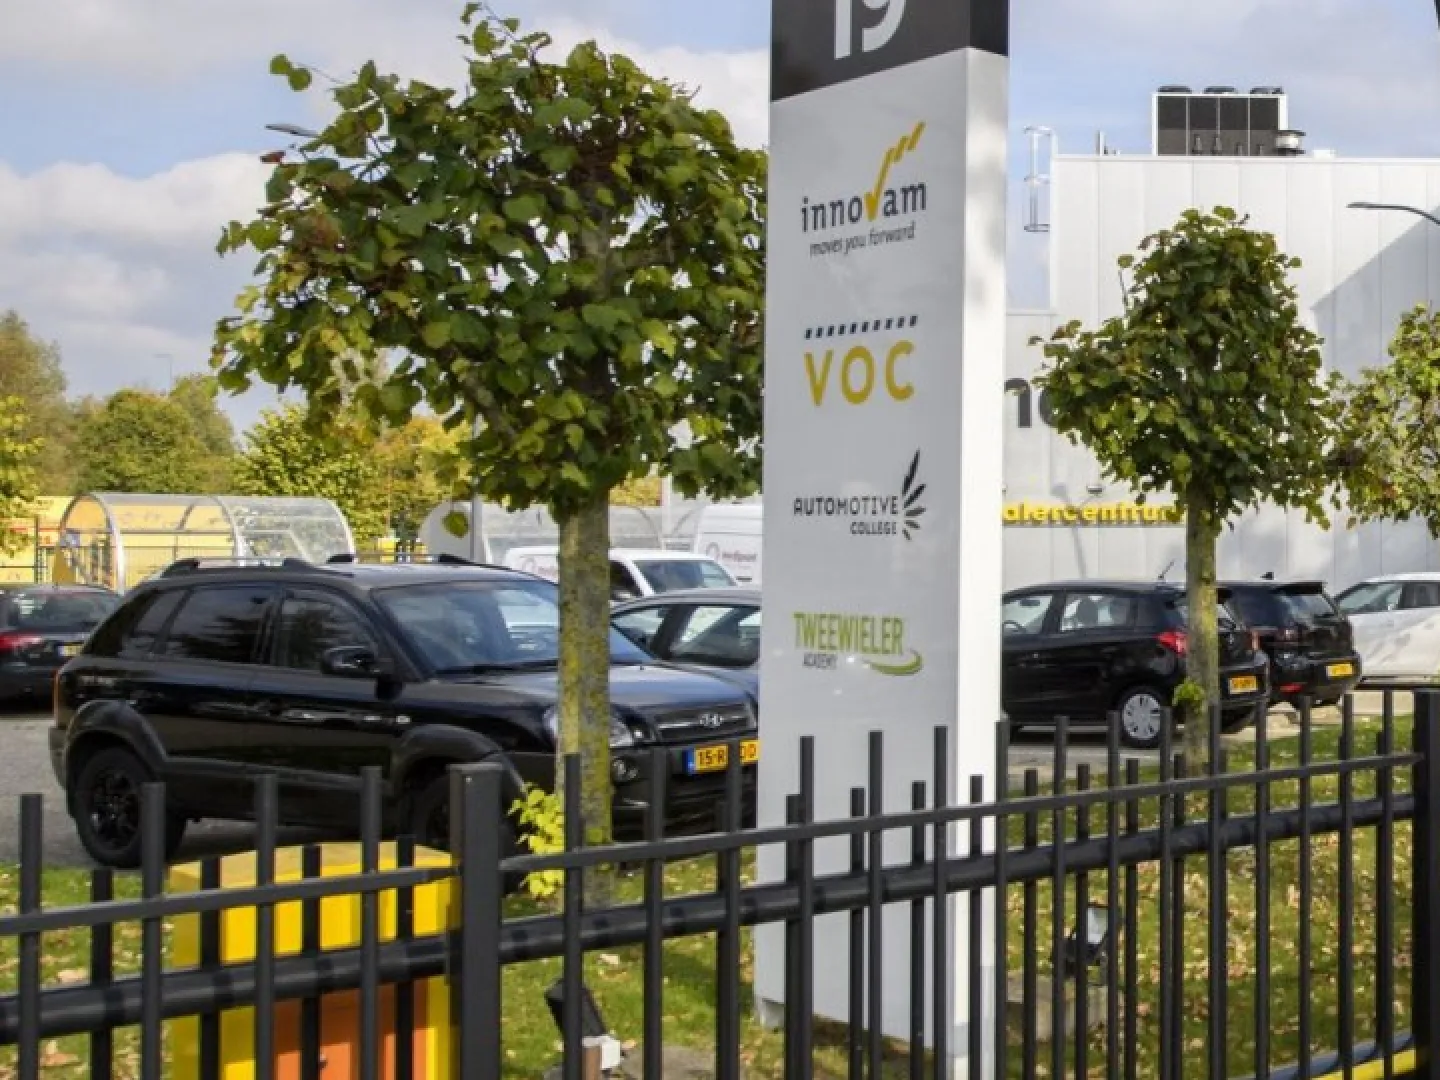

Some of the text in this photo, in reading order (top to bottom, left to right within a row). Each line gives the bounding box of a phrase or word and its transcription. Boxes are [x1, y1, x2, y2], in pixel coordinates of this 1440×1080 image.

[801, 170, 926, 232] innovam
[844, 235, 867, 255] you
[869, 220, 915, 246] forward
[804, 340, 915, 406] VOC
[793, 496, 898, 516] AUTOMOTIVE
[1002, 501, 1186, 524] alercentru
[849, 521, 897, 535] COLLEGE
[793, 612, 903, 655] TWEEWIELER
